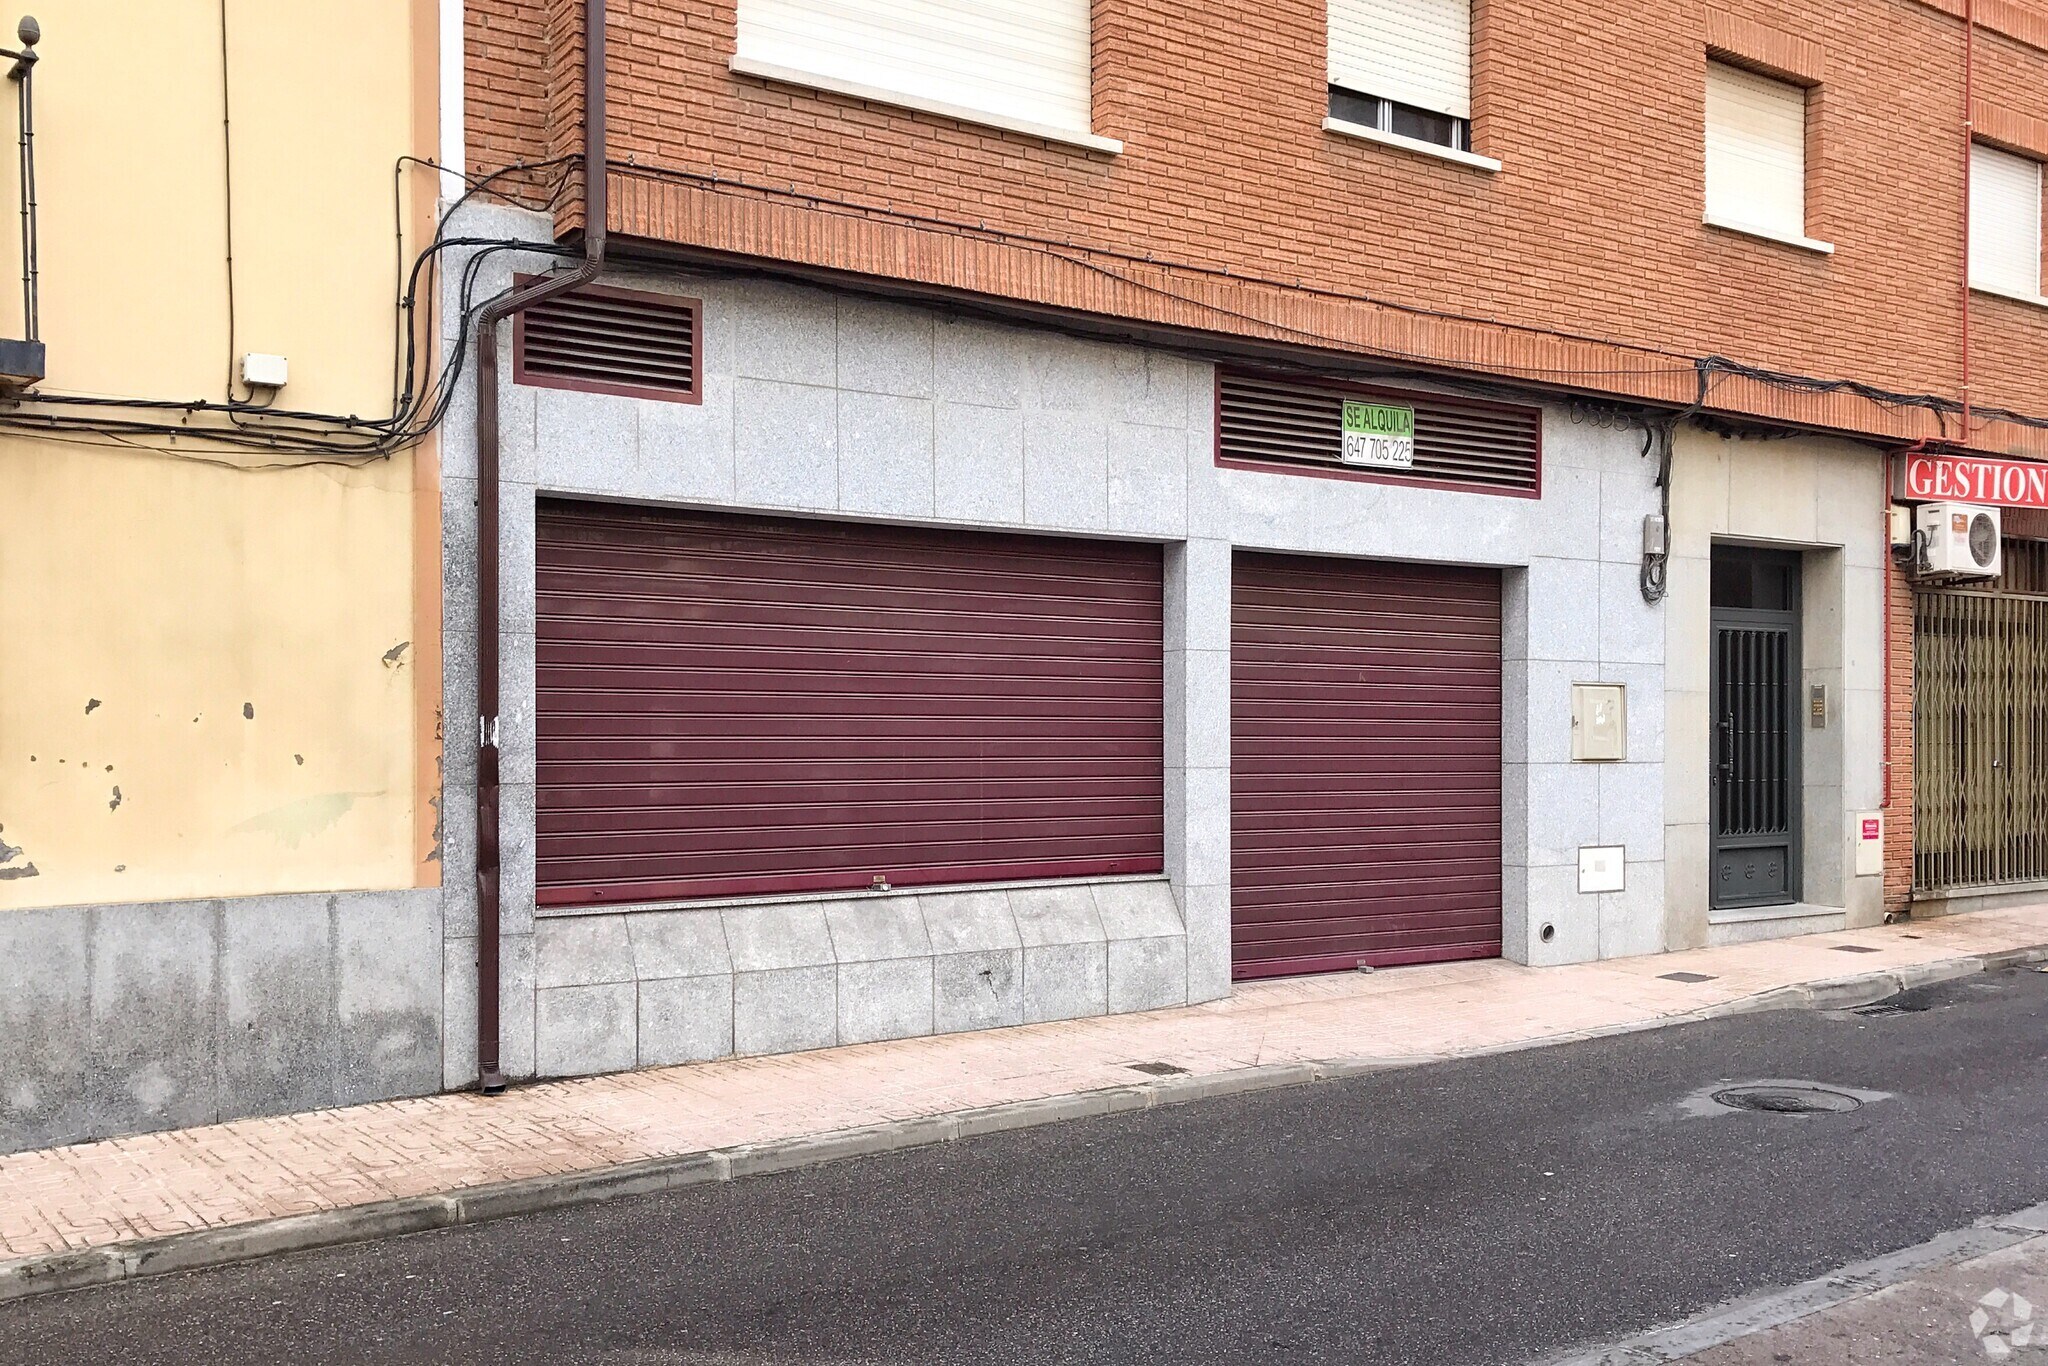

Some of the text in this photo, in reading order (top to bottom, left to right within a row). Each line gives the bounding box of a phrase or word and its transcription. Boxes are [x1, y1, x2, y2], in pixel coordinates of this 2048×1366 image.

[1346, 405, 1411, 433] SE ALQUILA
[1346, 435, 1411, 462] 647 705 225
[1909, 458, 2048, 503] GESTION
